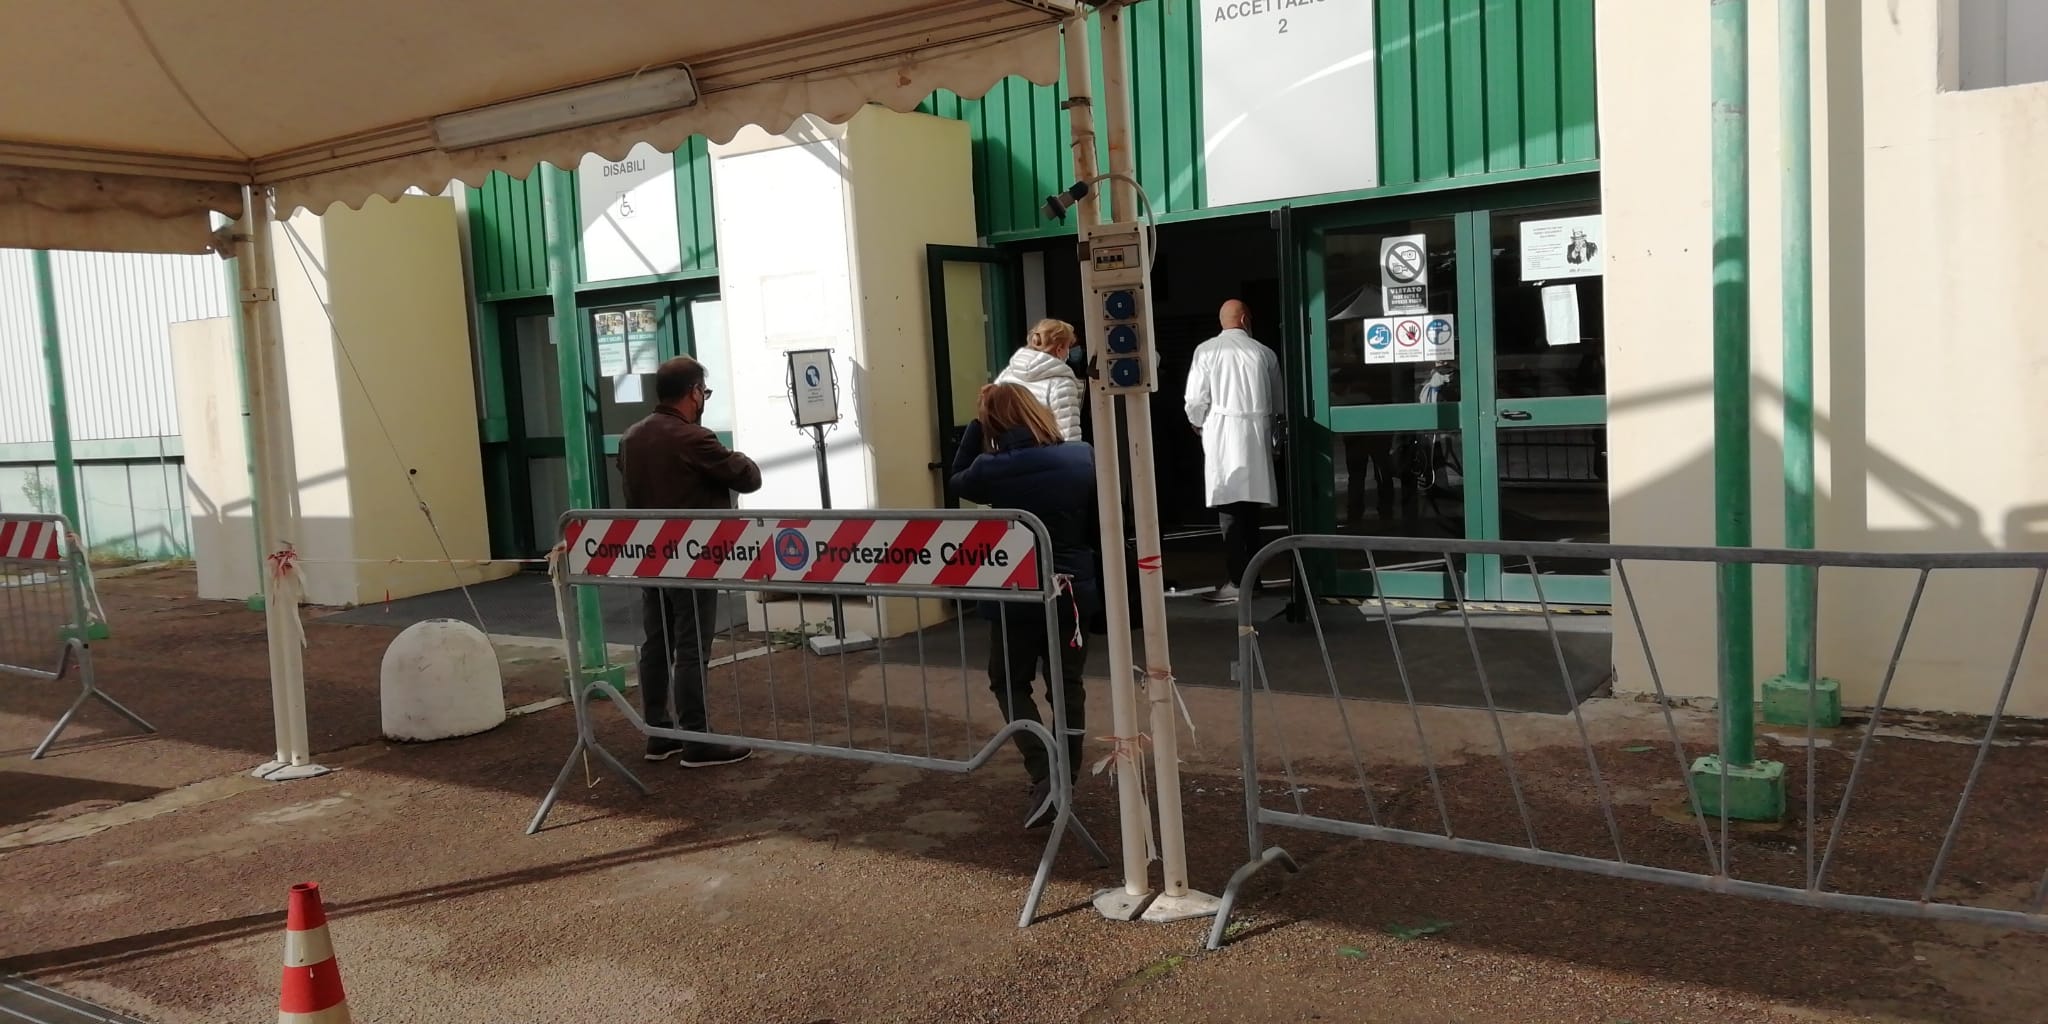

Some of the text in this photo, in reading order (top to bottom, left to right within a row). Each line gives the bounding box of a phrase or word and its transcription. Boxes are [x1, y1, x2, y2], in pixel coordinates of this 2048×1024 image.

[1277, 18, 1288, 34] 2
[603, 160, 646, 177] DISABILI
[585, 538, 761, 566] Comune di Cagliari
[815, 541, 1009, 567] Protezione Civile
